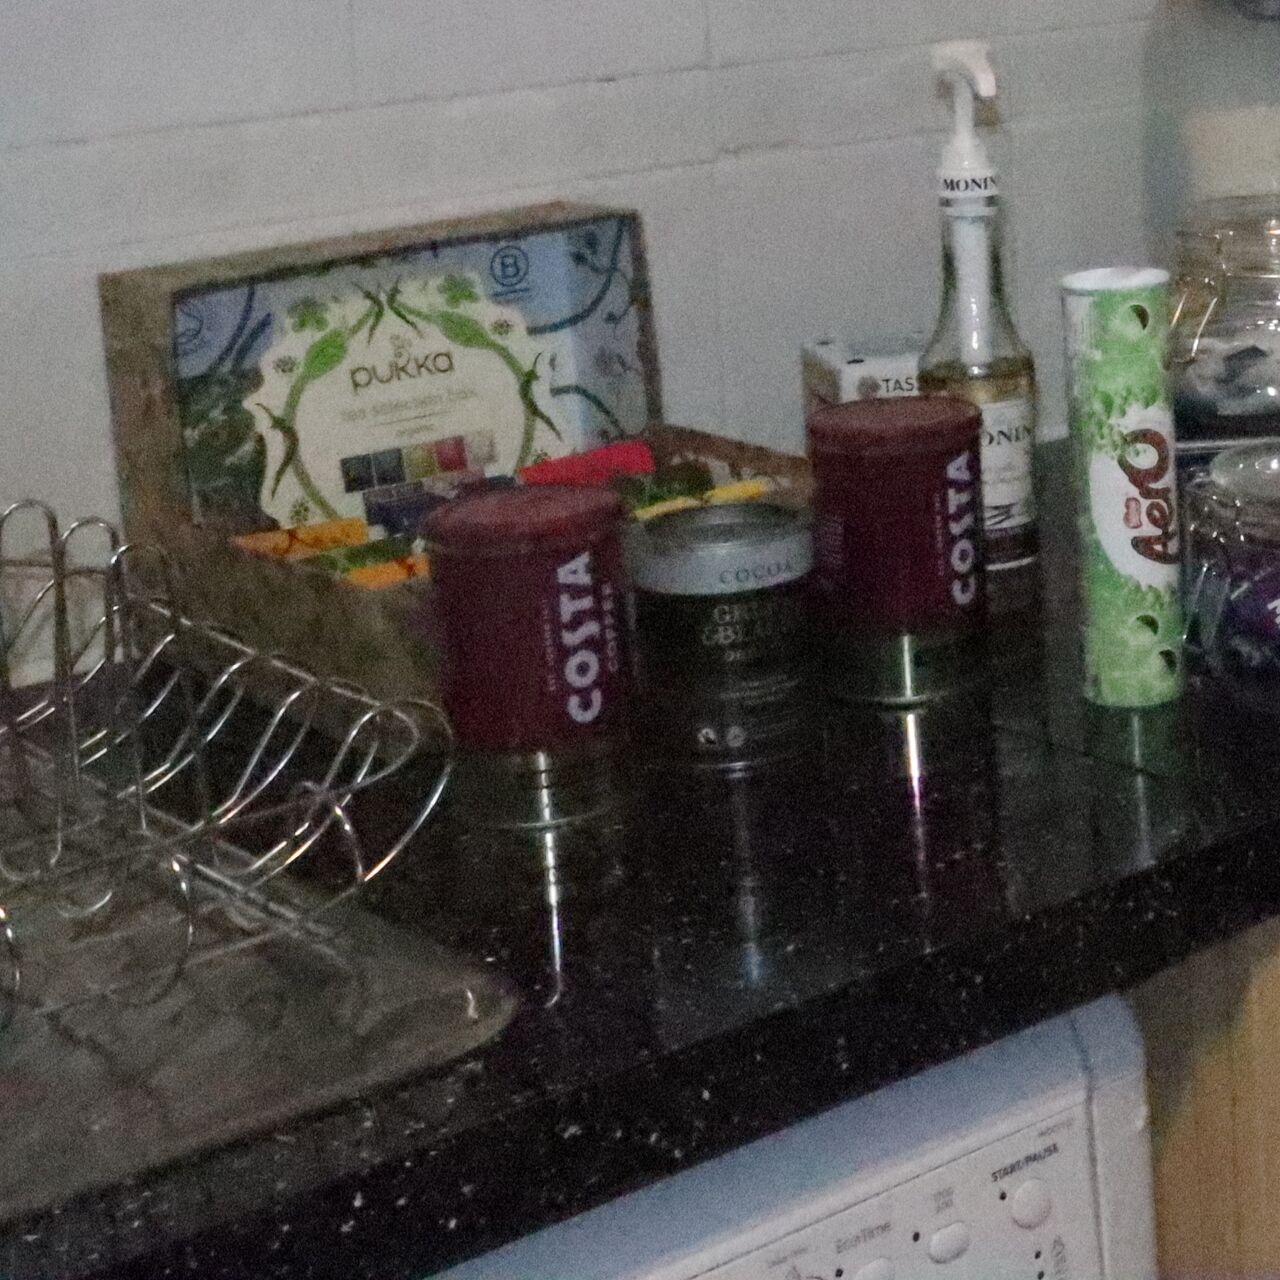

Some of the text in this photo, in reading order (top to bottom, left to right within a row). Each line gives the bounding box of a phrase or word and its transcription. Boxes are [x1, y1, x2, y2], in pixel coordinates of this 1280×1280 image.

[350, 352, 454, 396] pukka
[882, 377, 916, 393] TAS
[981, 426, 1032, 446] ONIN
[943, 451, 977, 606] COSTA
[719, 563, 793, 585] COCOA
[556, 550, 602, 724] COSTA
